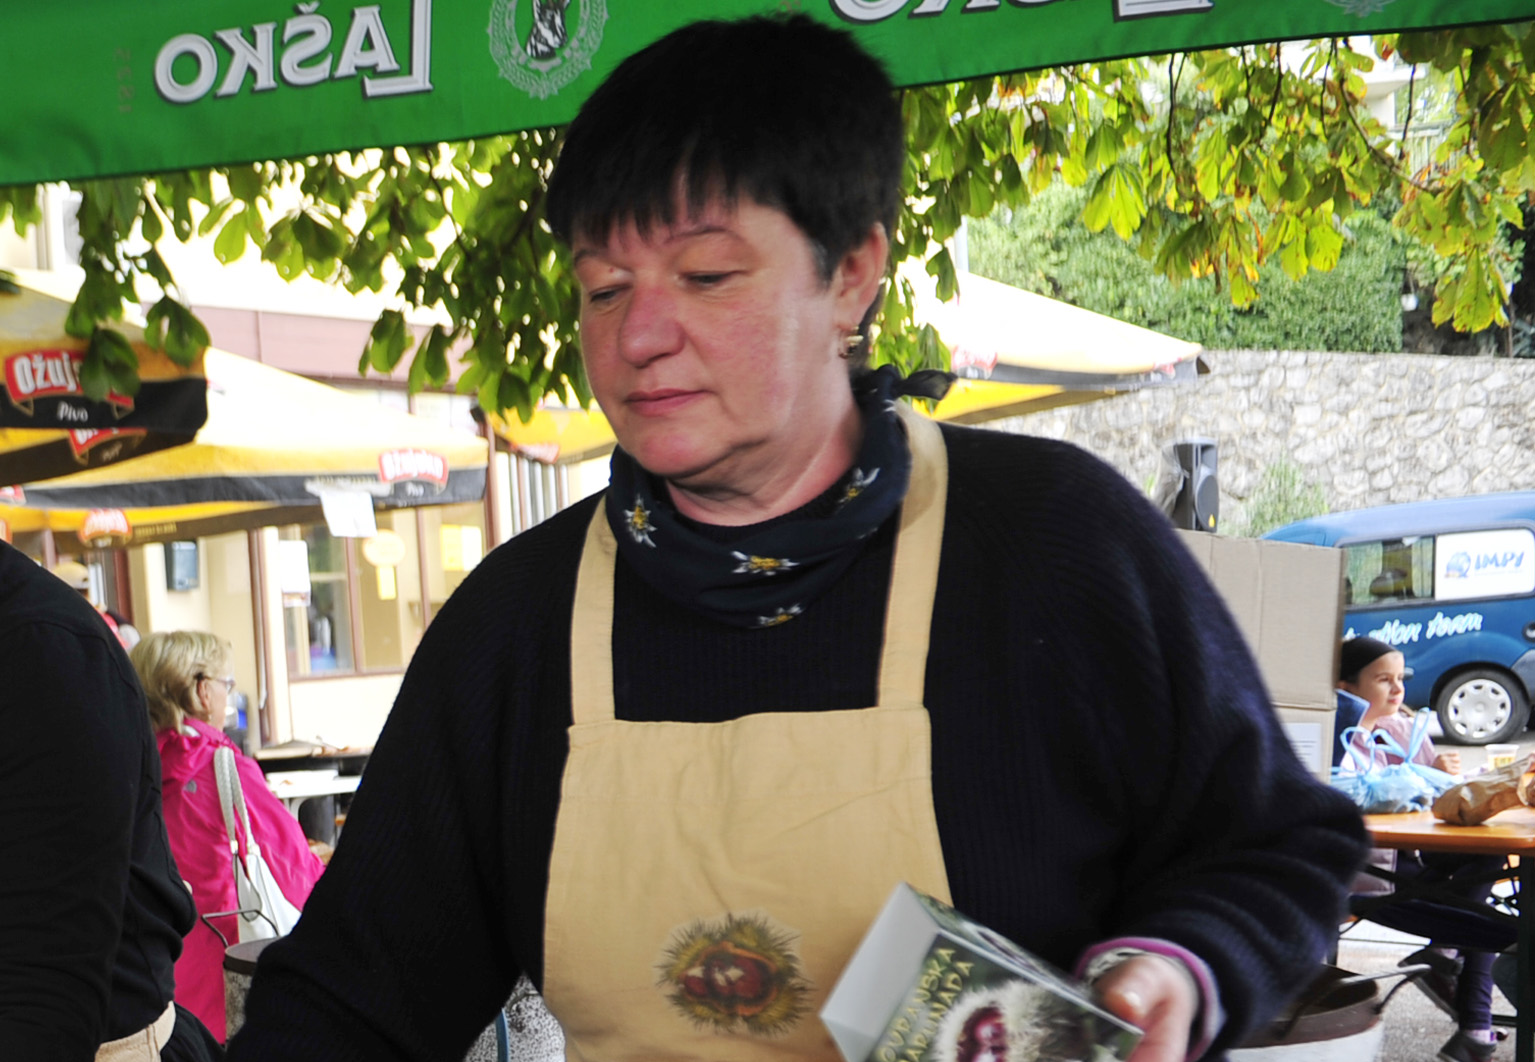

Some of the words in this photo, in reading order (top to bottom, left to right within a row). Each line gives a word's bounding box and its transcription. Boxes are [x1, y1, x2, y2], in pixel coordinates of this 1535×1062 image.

[14, 351, 84, 395] Ožuj
[57, 401, 88, 422] Pivo
[1426, 612, 1483, 639] team
